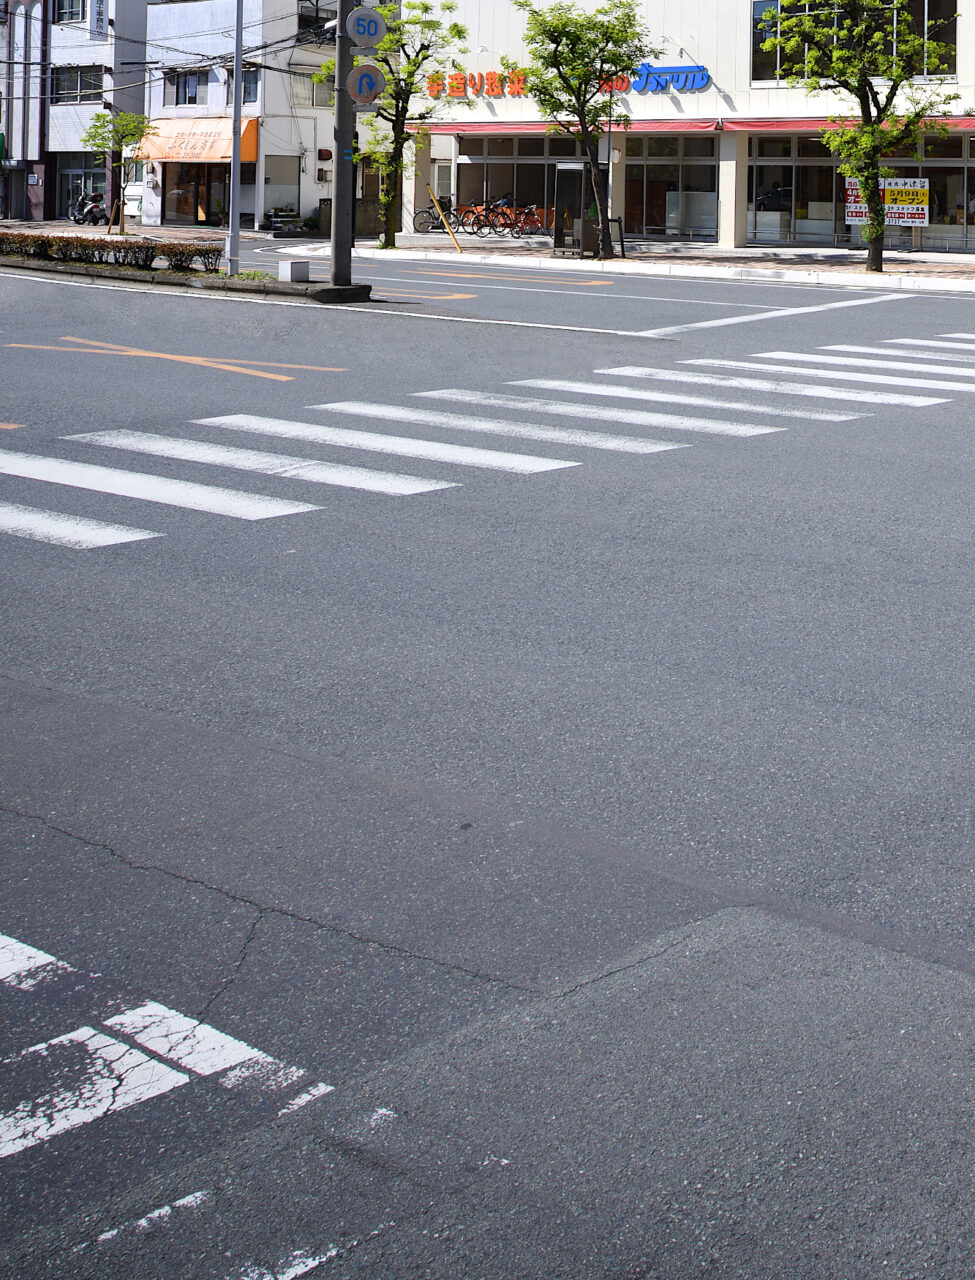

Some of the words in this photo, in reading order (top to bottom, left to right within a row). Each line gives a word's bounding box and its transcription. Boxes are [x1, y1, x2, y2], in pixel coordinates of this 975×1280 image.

[356, 18, 378, 36] 50
[426, 70, 527, 97] 手造り惣菜
[890, 197, 925, 205] オープン
